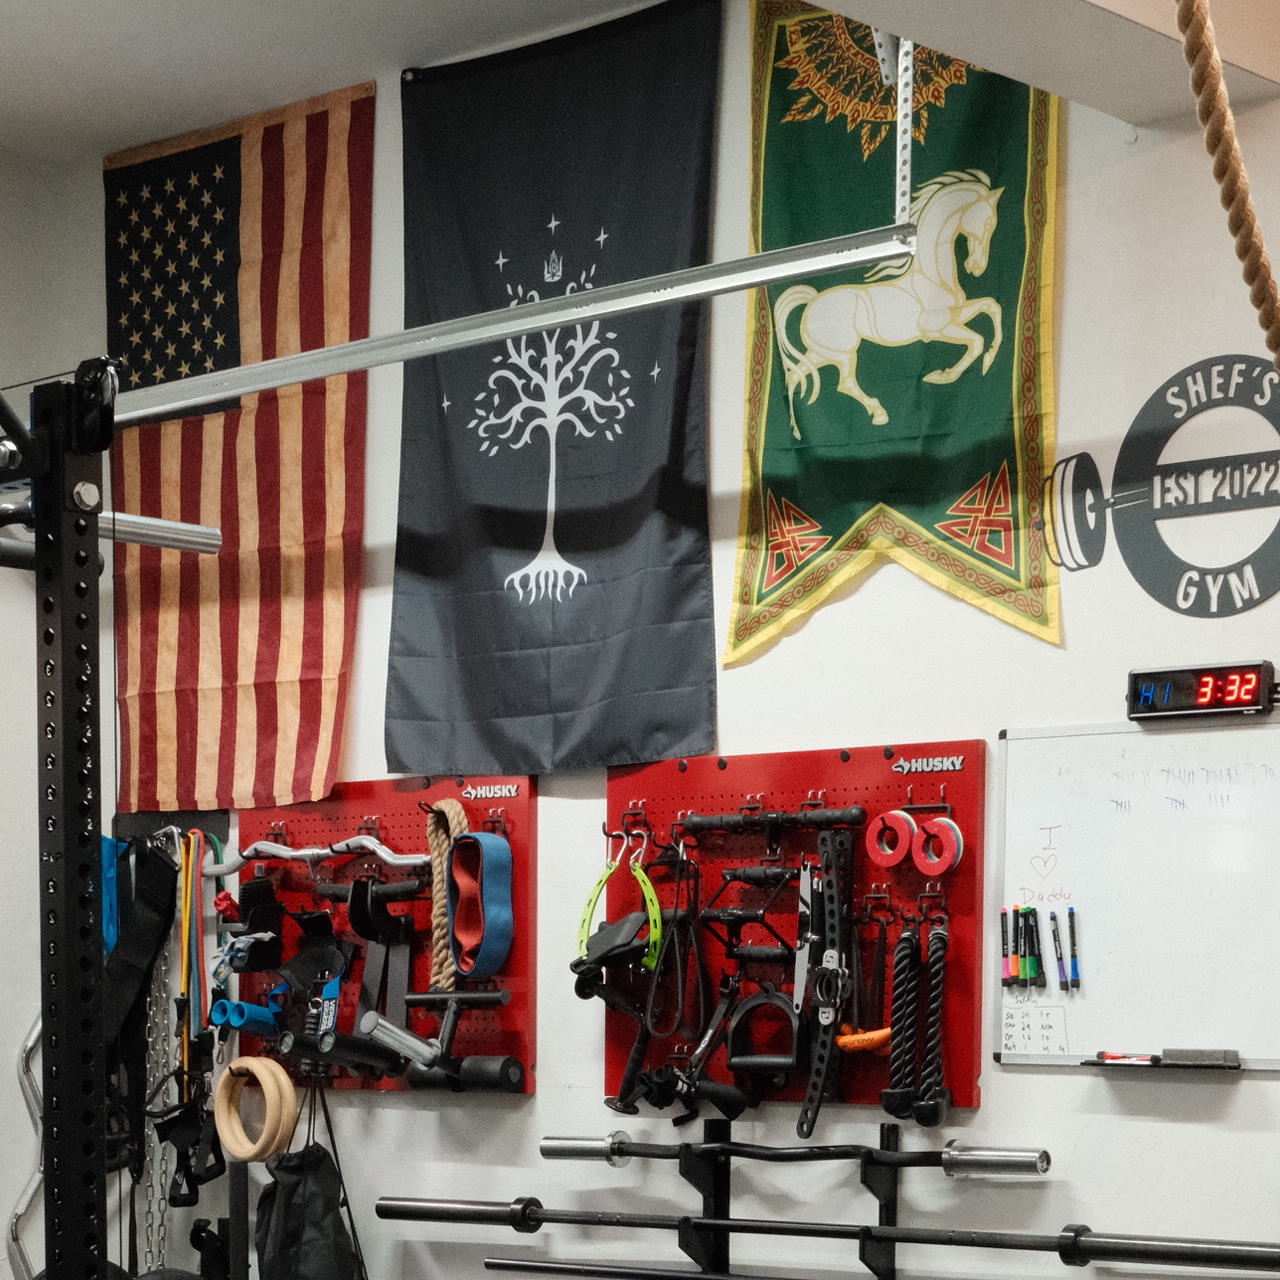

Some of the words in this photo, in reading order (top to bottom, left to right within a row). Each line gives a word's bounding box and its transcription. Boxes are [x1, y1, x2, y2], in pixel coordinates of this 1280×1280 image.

[1166, 363, 1279, 419] SHEF'S
[1176, 563, 1260, 613] GYM
[1199, 673, 1257, 705] 3:32
[911, 755, 964, 772] HUSKY
[476, 785, 518, 798] HUSKY
